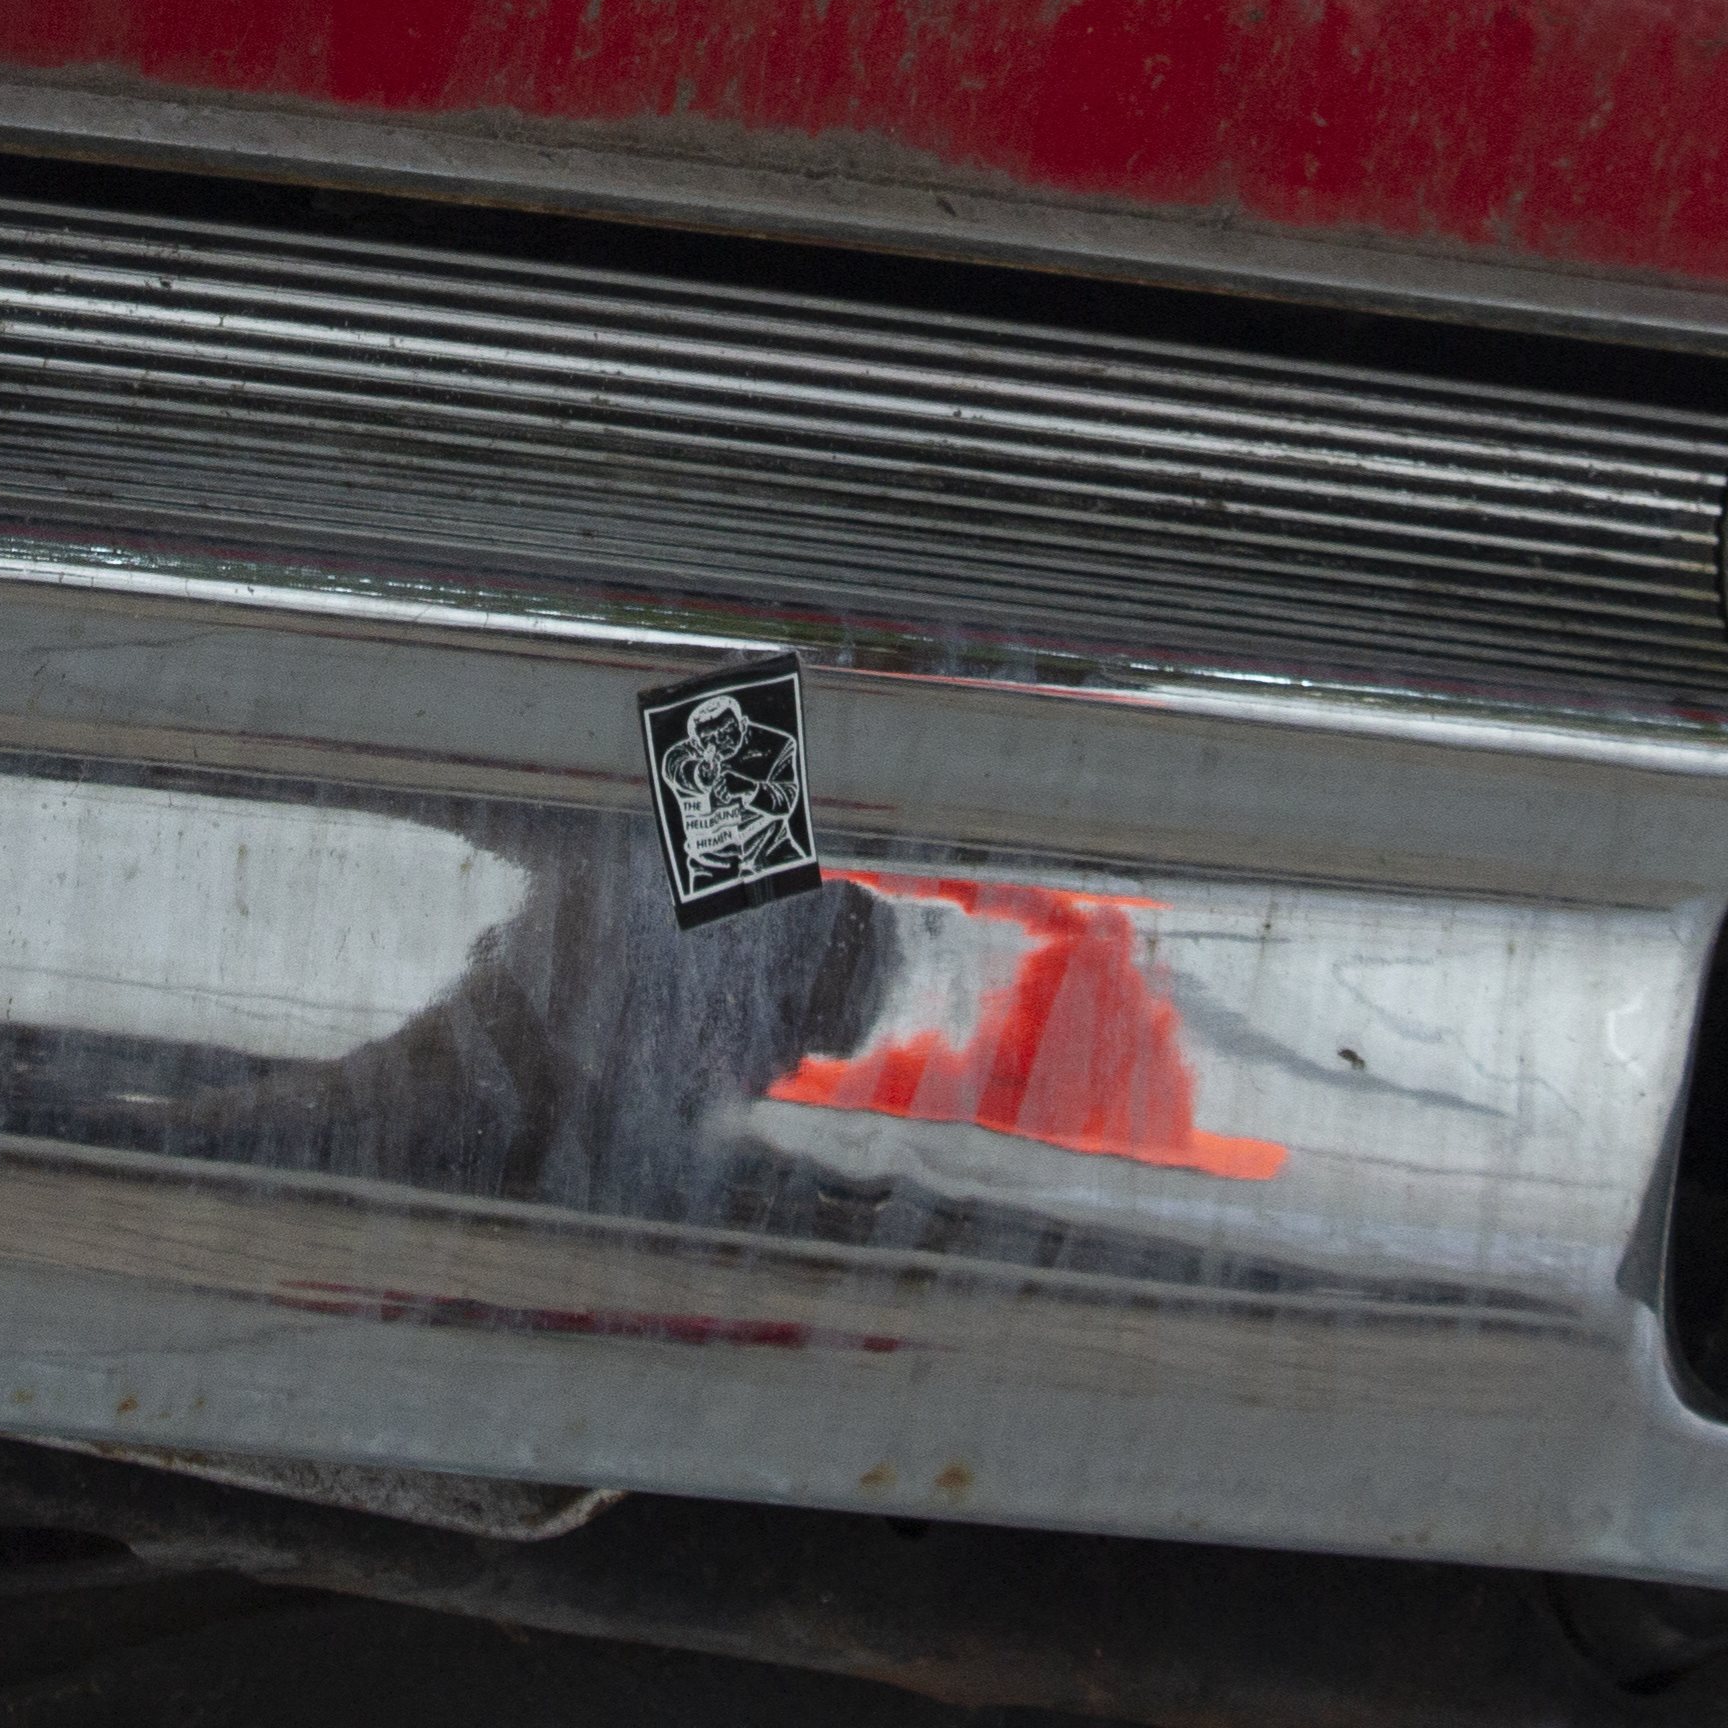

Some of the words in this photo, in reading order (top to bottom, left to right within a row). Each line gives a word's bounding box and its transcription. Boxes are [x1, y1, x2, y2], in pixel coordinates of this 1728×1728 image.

[683, 801, 701, 812] THE
[686, 807, 741, 830] HELLBOUND
[696, 831, 732, 849] HITMEN
